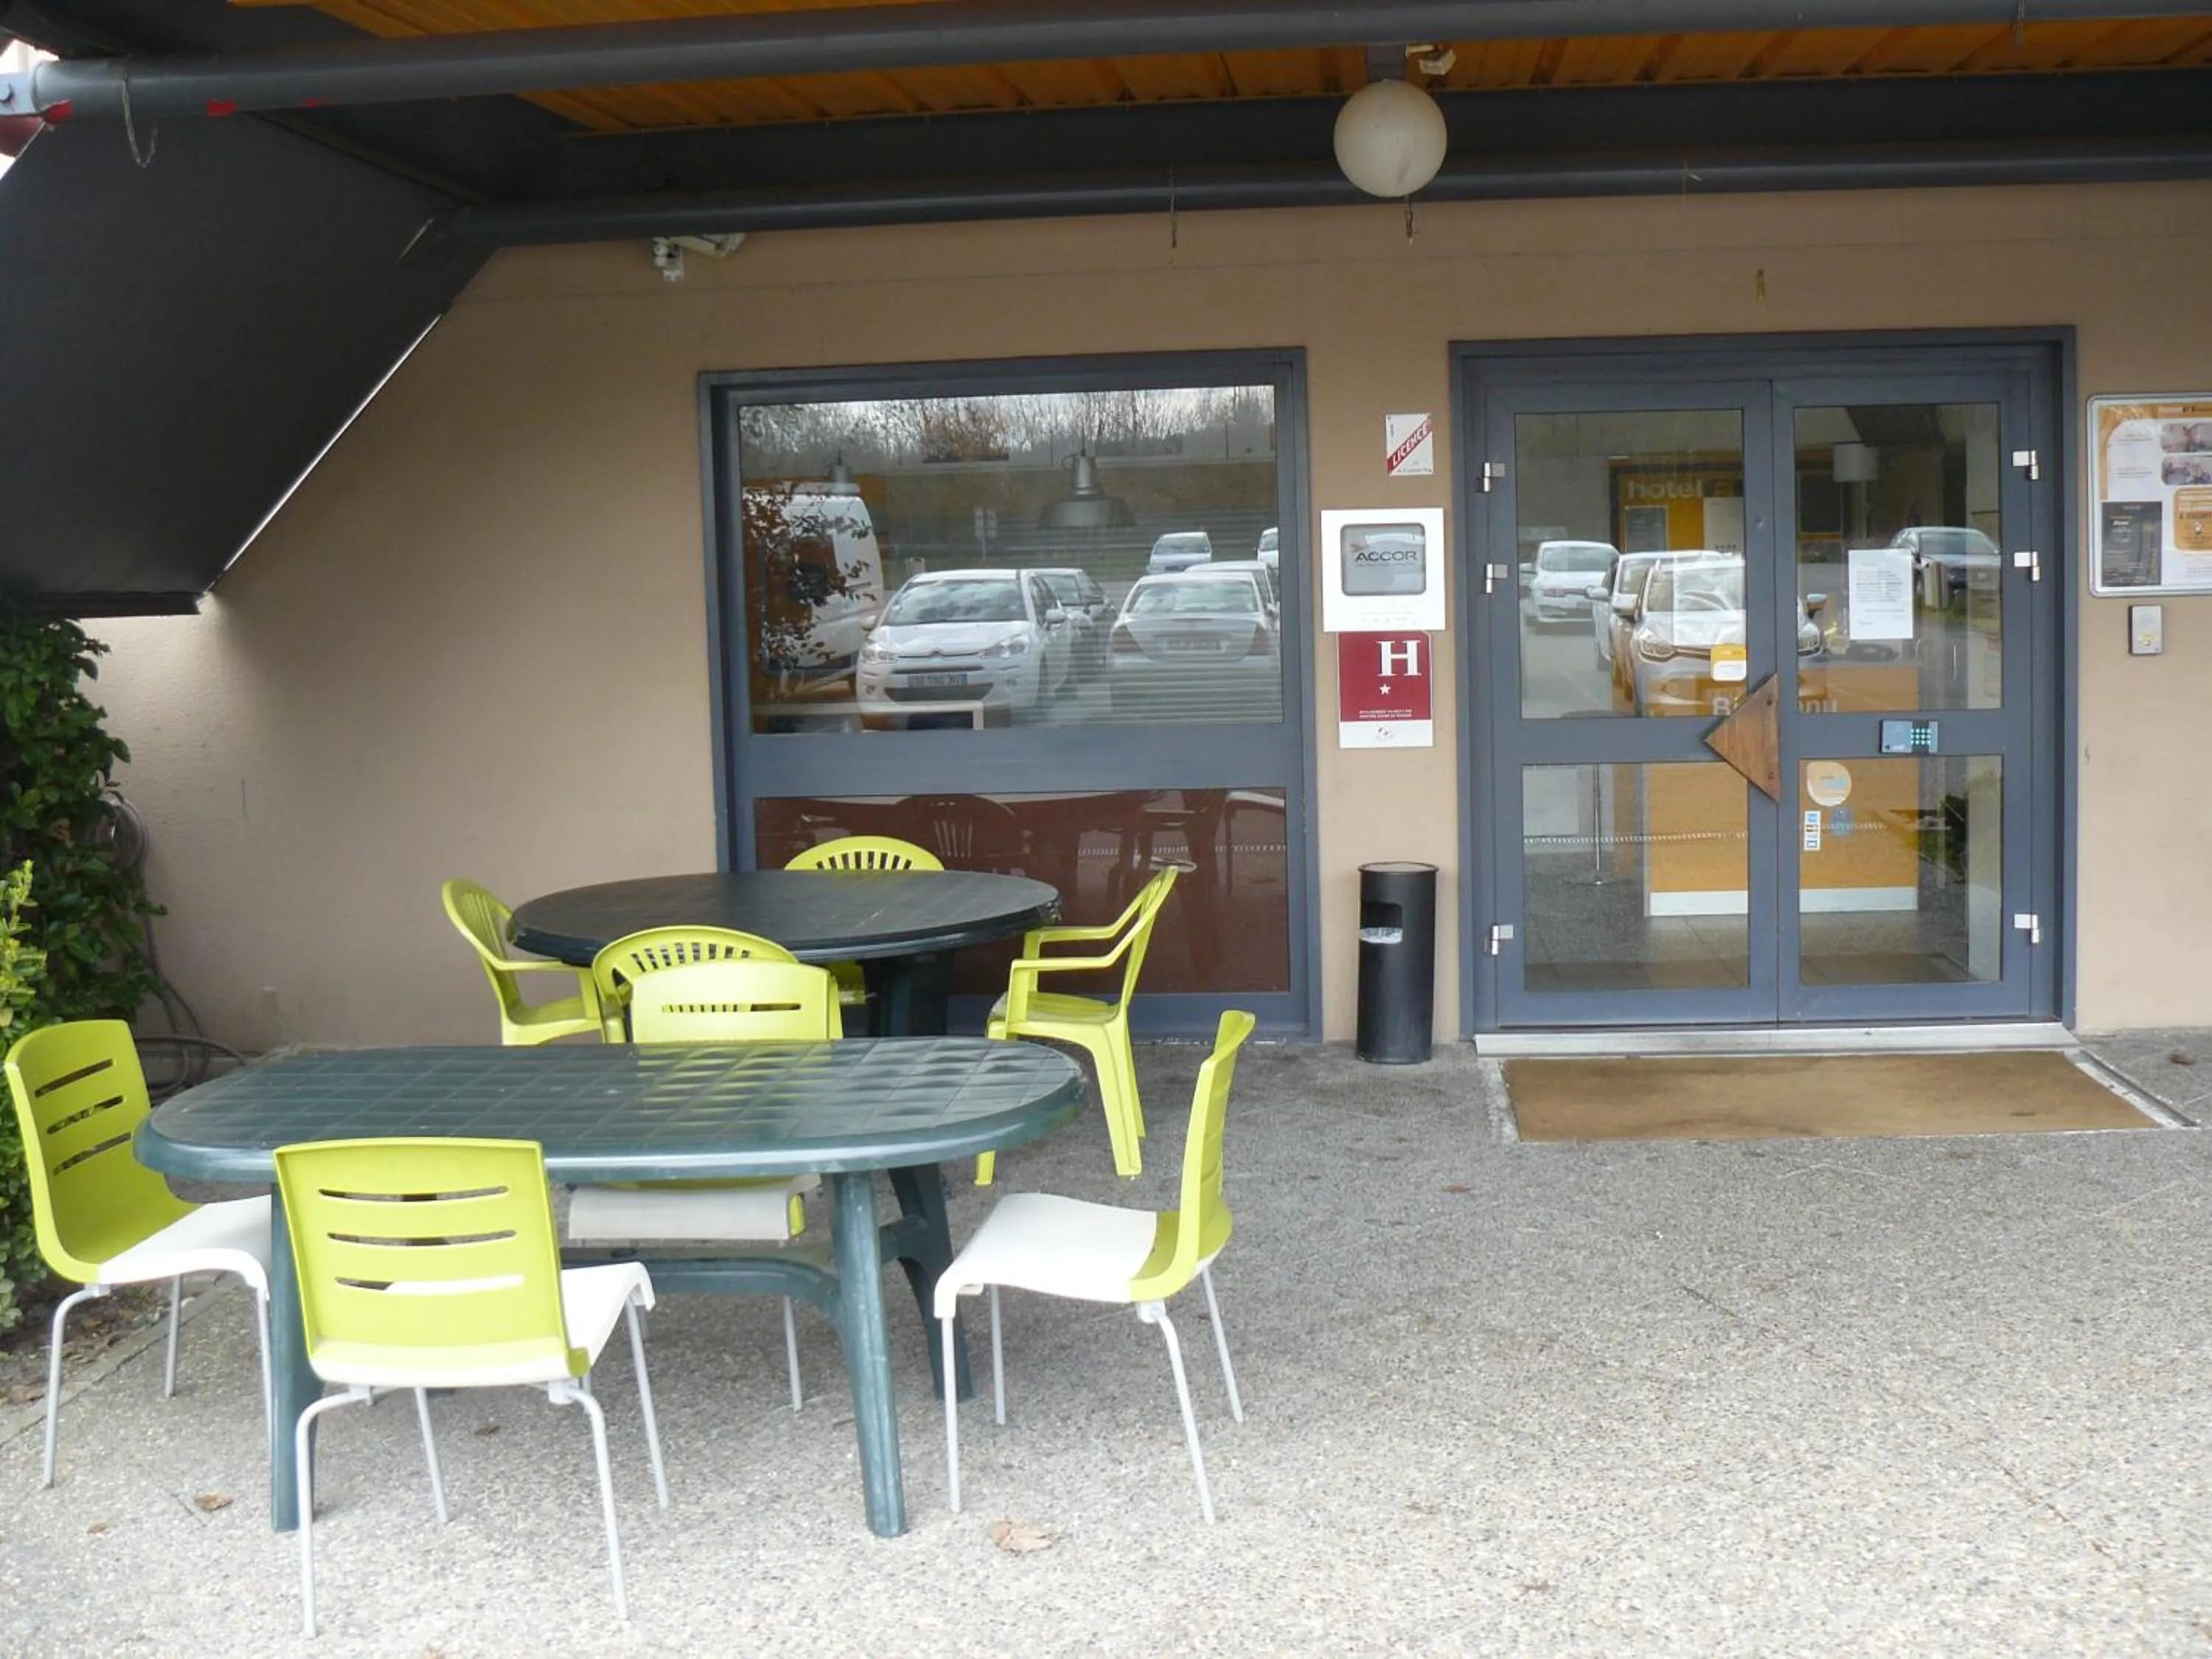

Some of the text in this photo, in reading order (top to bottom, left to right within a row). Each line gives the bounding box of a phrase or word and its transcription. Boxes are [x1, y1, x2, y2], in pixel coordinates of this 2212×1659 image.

[1393, 421, 1430, 467] LICENCE
[1627, 481, 1703, 499] hotel
[1355, 551, 1417, 562] ACCOR
[1376, 639, 1422, 677] H
